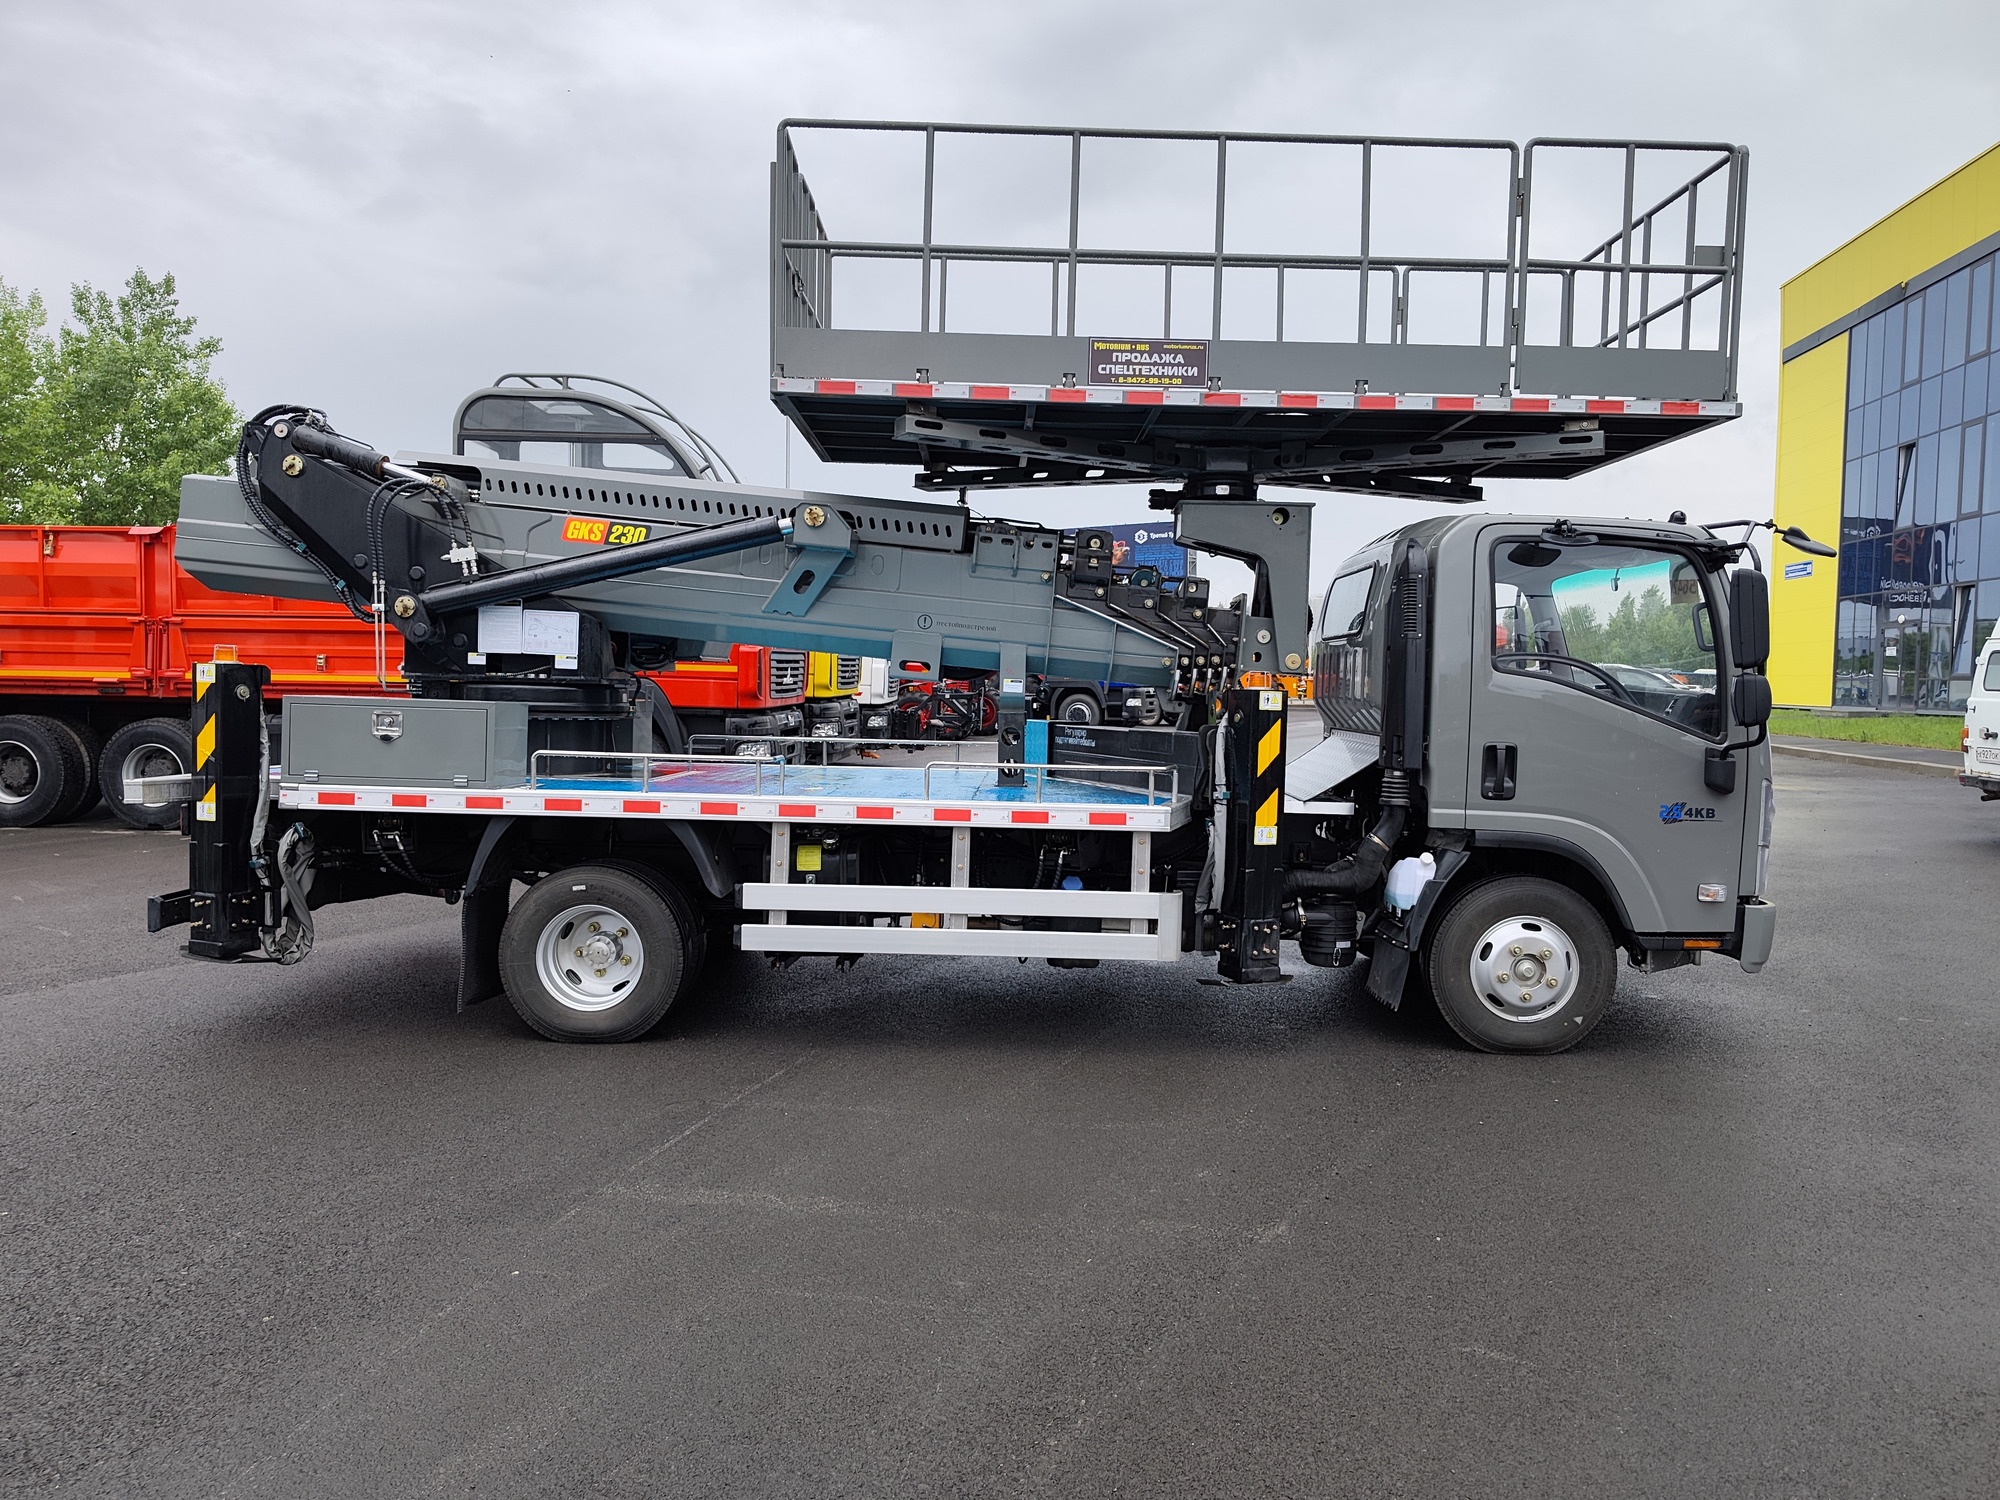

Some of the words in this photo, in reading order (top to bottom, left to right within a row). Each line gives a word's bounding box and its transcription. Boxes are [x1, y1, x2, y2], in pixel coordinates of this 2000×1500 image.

[1112, 352, 1185, 364] ПРОДАЖА
[1098, 364, 1198, 377] СПЕЦТЕХНИКИ
[566, 520, 605, 541] GKS
[608, 524, 647, 544] 230
[1684, 807, 1716, 819] 4KB
